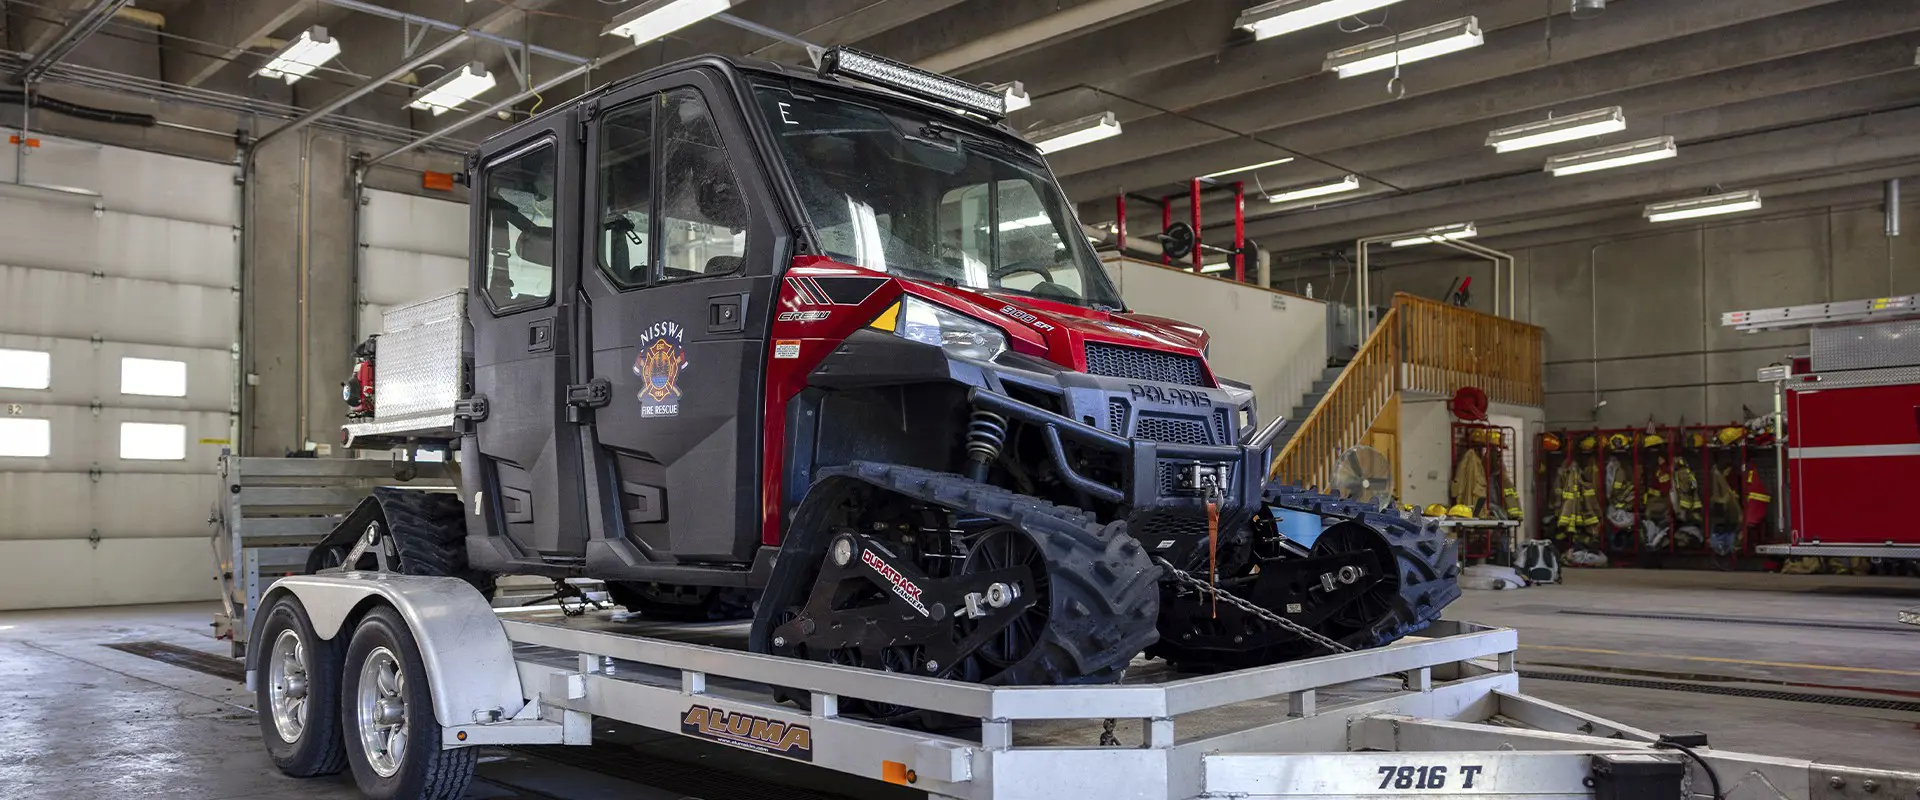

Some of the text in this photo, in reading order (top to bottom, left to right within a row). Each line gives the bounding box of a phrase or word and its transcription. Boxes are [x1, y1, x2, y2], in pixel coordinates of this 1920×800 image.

[778, 102, 799, 124] E
[778, 311, 831, 321] CREW
[1000, 305, 1037, 323] 900
[640, 321, 684, 346] NISSWA
[1128, 384, 1212, 407] POLARIS
[641, 404, 678, 415] FIRE RESCUE
[475, 491, 483, 515] 1
[862, 548, 922, 601] DURATRACK
[684, 706, 810, 752] ALUMA
[1378, 765, 1483, 789] 7816 T
